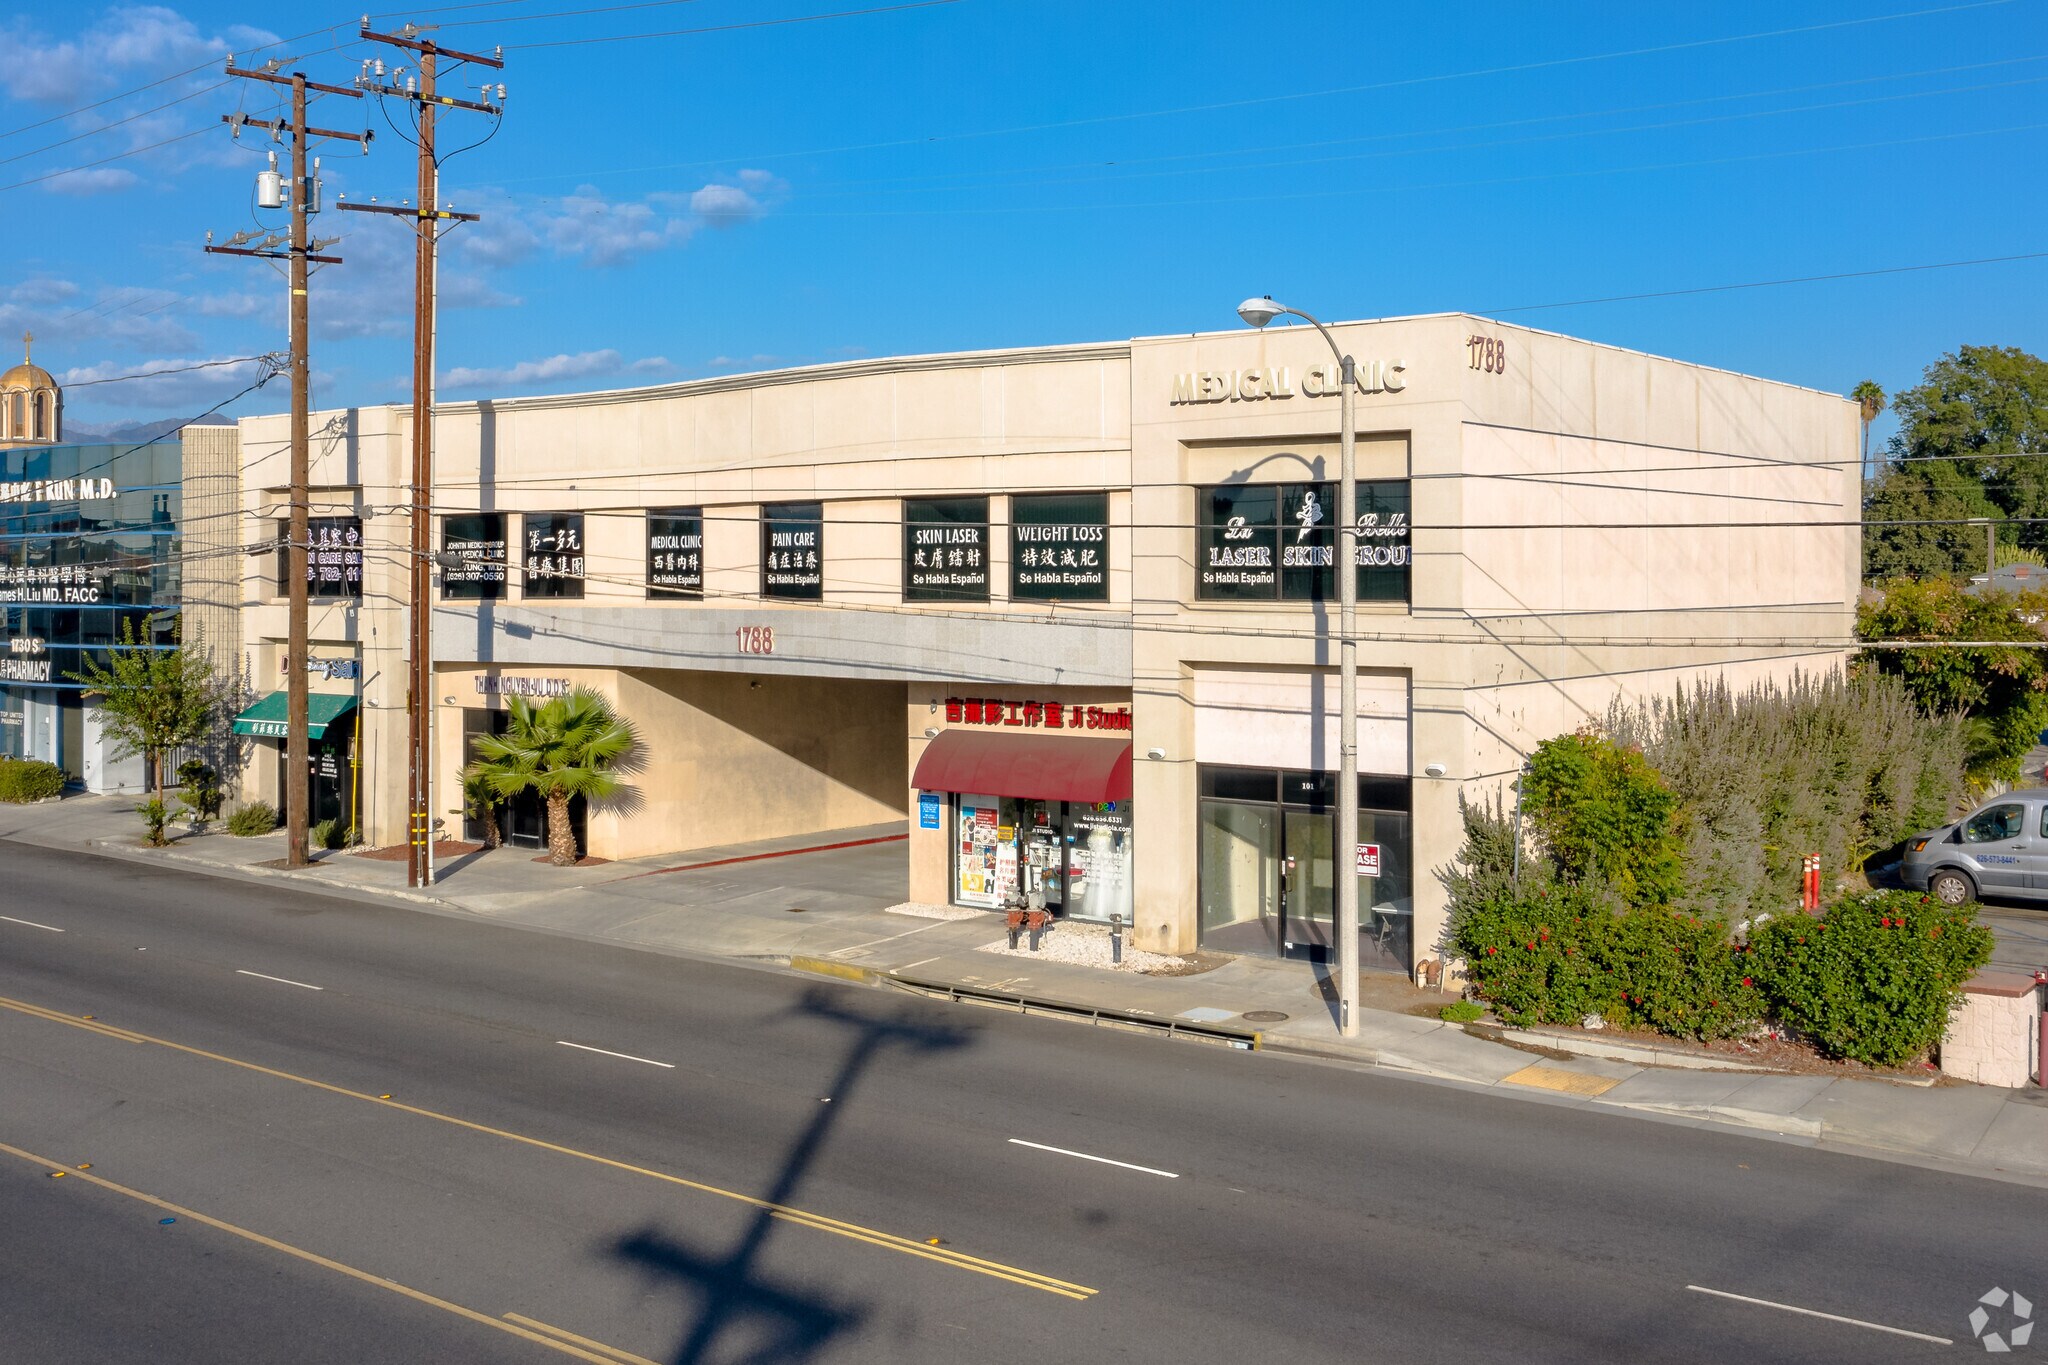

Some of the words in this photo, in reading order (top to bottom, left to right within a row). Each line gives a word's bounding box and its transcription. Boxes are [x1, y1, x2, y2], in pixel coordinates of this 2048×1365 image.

[1467, 335, 1505, 374] 1788
[1170, 366, 1294, 405] MEDICAL
[1302, 358, 1407, 397] CLINIC
[80, 478, 117, 500] M.D.
[528, 530, 580, 551] 第一多元
[651, 536, 679, 549] MEDICAL
[680, 535, 702, 549] CLINIC
[772, 533, 792, 547] PAIN
[793, 532, 815, 546] CARE
[916, 530, 943, 544] SKIN
[946, 528, 979, 543] LASER
[1017, 526, 1070, 542] WEIGHT
[1072, 526, 1103, 541] LOSS
[318, 552, 342, 564] CARE
[345, 552, 363, 564] SAL
[654, 553, 698, 571] 西醫內科
[768, 551, 818, 570] 痛症治療
[914, 548, 981, 569] 皮膚鐳射
[1021, 548, 1099, 568] 特效減肥
[1209, 546, 1272, 567] LASER
[1283, 545, 1333, 567] SKIN
[466, 572, 505, 581] 307-0550
[653, 575, 661, 583] Se
[662, 575, 677, 584] Habla
[678, 575, 700, 587] Español
[768, 575, 776, 584] Se
[776, 574, 794, 584] Habla
[794, 573, 820, 586] Español
[913, 574, 924, 584] Se
[925, 573, 949, 584] Habla
[951, 572, 985, 586] Español
[1019, 573, 1032, 584] Se
[1034, 572, 1061, 584] Habla
[1063, 571, 1101, 586] Español
[1203, 572, 1214, 583] Se
[1216, 572, 1239, 583] Habla
[1241, 571, 1274, 586] Español
[27, 587, 40, 602] Liu
[43, 587, 62, 602] MD.
[64, 587, 98, 602] FACC
[11, 638, 30, 653] 1730
[736, 626, 774, 654] 1788
[7, 660, 51, 681] PHARMACY
[1069, 705, 1084, 729] Ji
[1357, 854, 1377, 866] ASE
